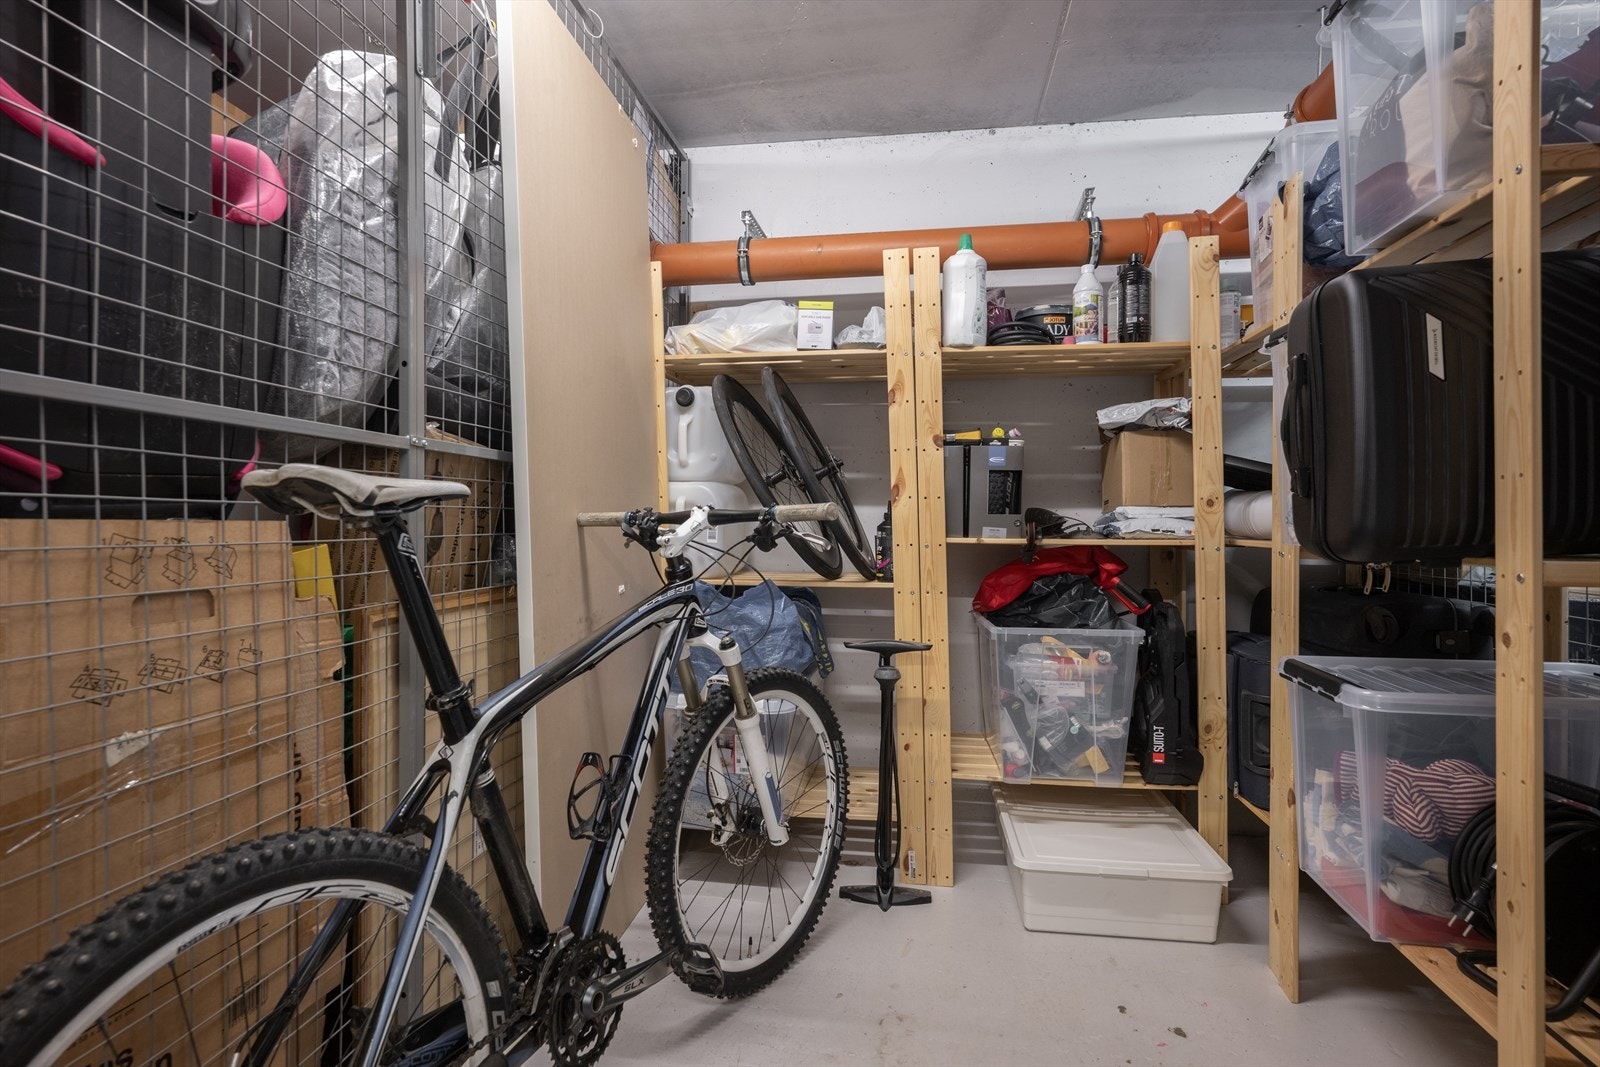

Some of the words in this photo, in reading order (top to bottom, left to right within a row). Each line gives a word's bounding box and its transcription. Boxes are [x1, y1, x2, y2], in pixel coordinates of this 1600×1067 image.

[1046, 324, 1071, 336] ADY
[638, 590, 675, 613] SCALE
[676, 583, 694, 595] 30
[1153, 725, 1165, 752] SUITO-T
[606, 656, 671, 887] SCOTT
[832, 740, 847, 850] SCHWALBE
[624, 976, 645, 993] SLX
